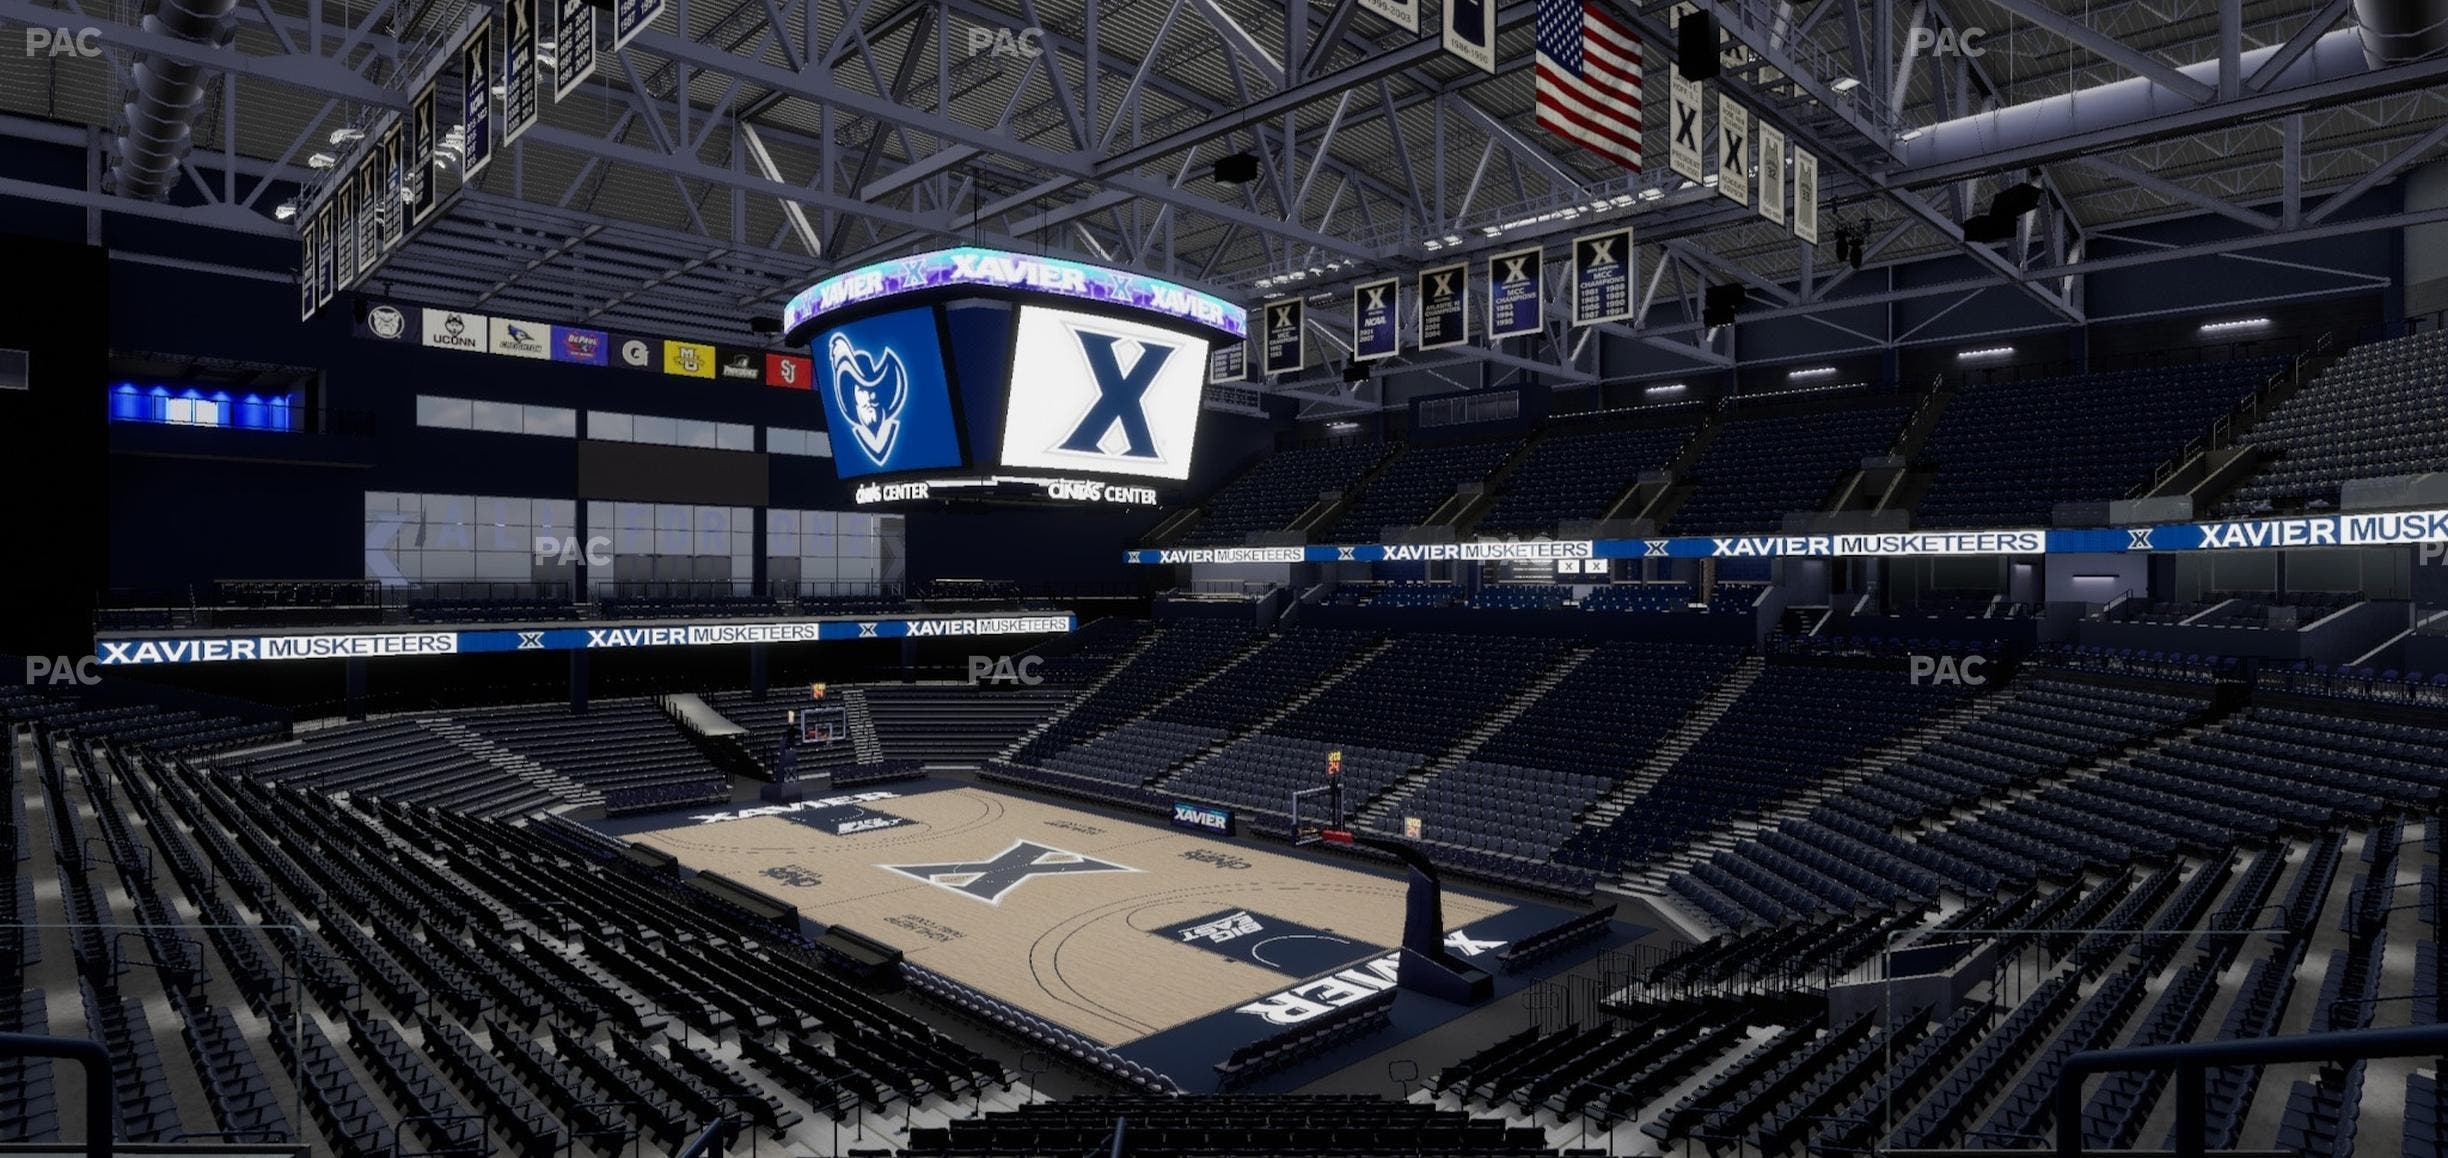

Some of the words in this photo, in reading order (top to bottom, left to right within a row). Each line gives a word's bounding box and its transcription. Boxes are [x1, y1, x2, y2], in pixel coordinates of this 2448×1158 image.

[1676, 100, 1697, 152] X
[1725, 127, 1742, 176] X
[1588, 238, 1616, 267] X
[1433, 271, 1456, 297] X
[1503, 256, 1530, 285] X
[1580, 275, 1625, 290] CHAMPIONS
[820, 271, 884, 310] XAVIER
[951, 255, 1087, 293] XAVIER
[1151, 284, 1224, 325] XAVIER
[1366, 287, 1388, 311] X
[1496, 292, 1537, 304] CHAMPIONS
[433, 334, 476, 348] UCONN
[1050, 324, 1180, 462] X
[883, 482, 929, 501] CENTER
[1104, 485, 1157, 505] CENTER
[1159, 549, 1213, 563] XAVIER
[1216, 547, 1302, 561] MUSKETEERS
[1383, 545, 1459, 560] XAVIER
[1465, 542, 1588, 558] MUSKETEERS
[1712, 537, 1831, 556] XAVIER
[1841, 532, 2039, 554] MUSKETEERS
[2198, 518, 2337, 549] XAVIER
[101, 637, 258, 665] XAVIER
[269, 633, 452, 656] MUSKETEERS
[587, 627, 687, 647] XAVIER
[694, 624, 816, 642] MUSKETEERS
[906, 620, 975, 637] XAVIER
[981, 617, 1067, 633] MUSKETEERS
[1174, 807, 1227, 829] XAVIER
